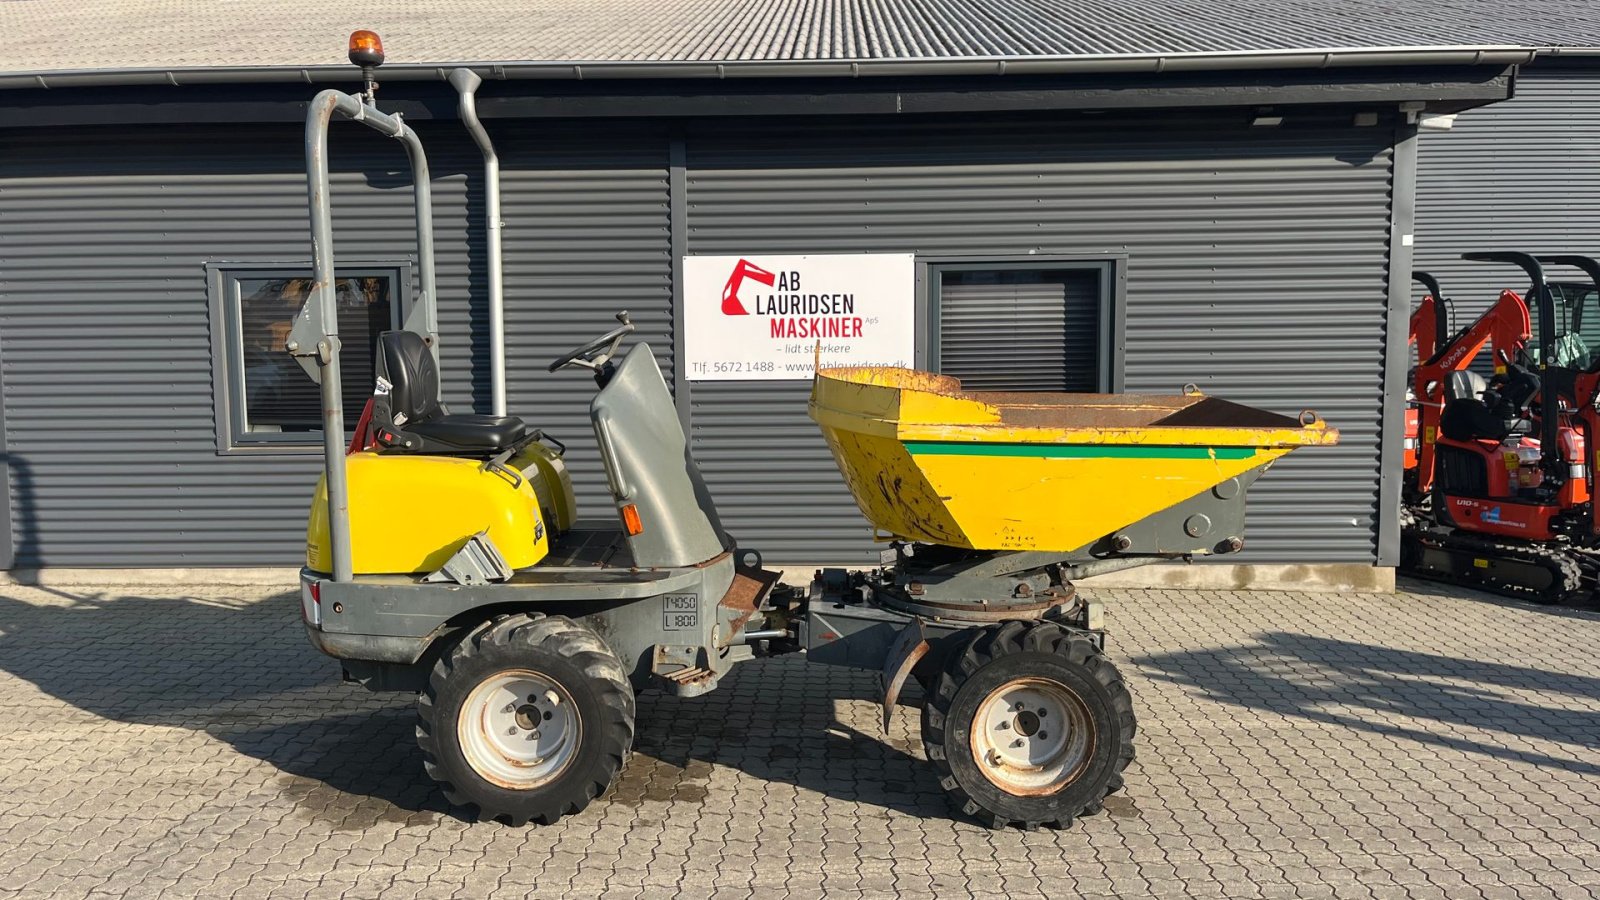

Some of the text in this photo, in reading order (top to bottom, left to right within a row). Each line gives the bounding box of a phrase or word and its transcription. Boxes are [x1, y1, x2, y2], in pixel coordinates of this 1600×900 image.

[778, 271, 801, 292] AB
[756, 294, 854, 315] LAURIDSEN
[770, 317, 863, 338] MASKINER
[785, 344, 801, 354] lidt
[692, 361, 711, 374] Tlf.
[713, 361, 742, 372] 5672
[745, 361, 775, 372] 1488
